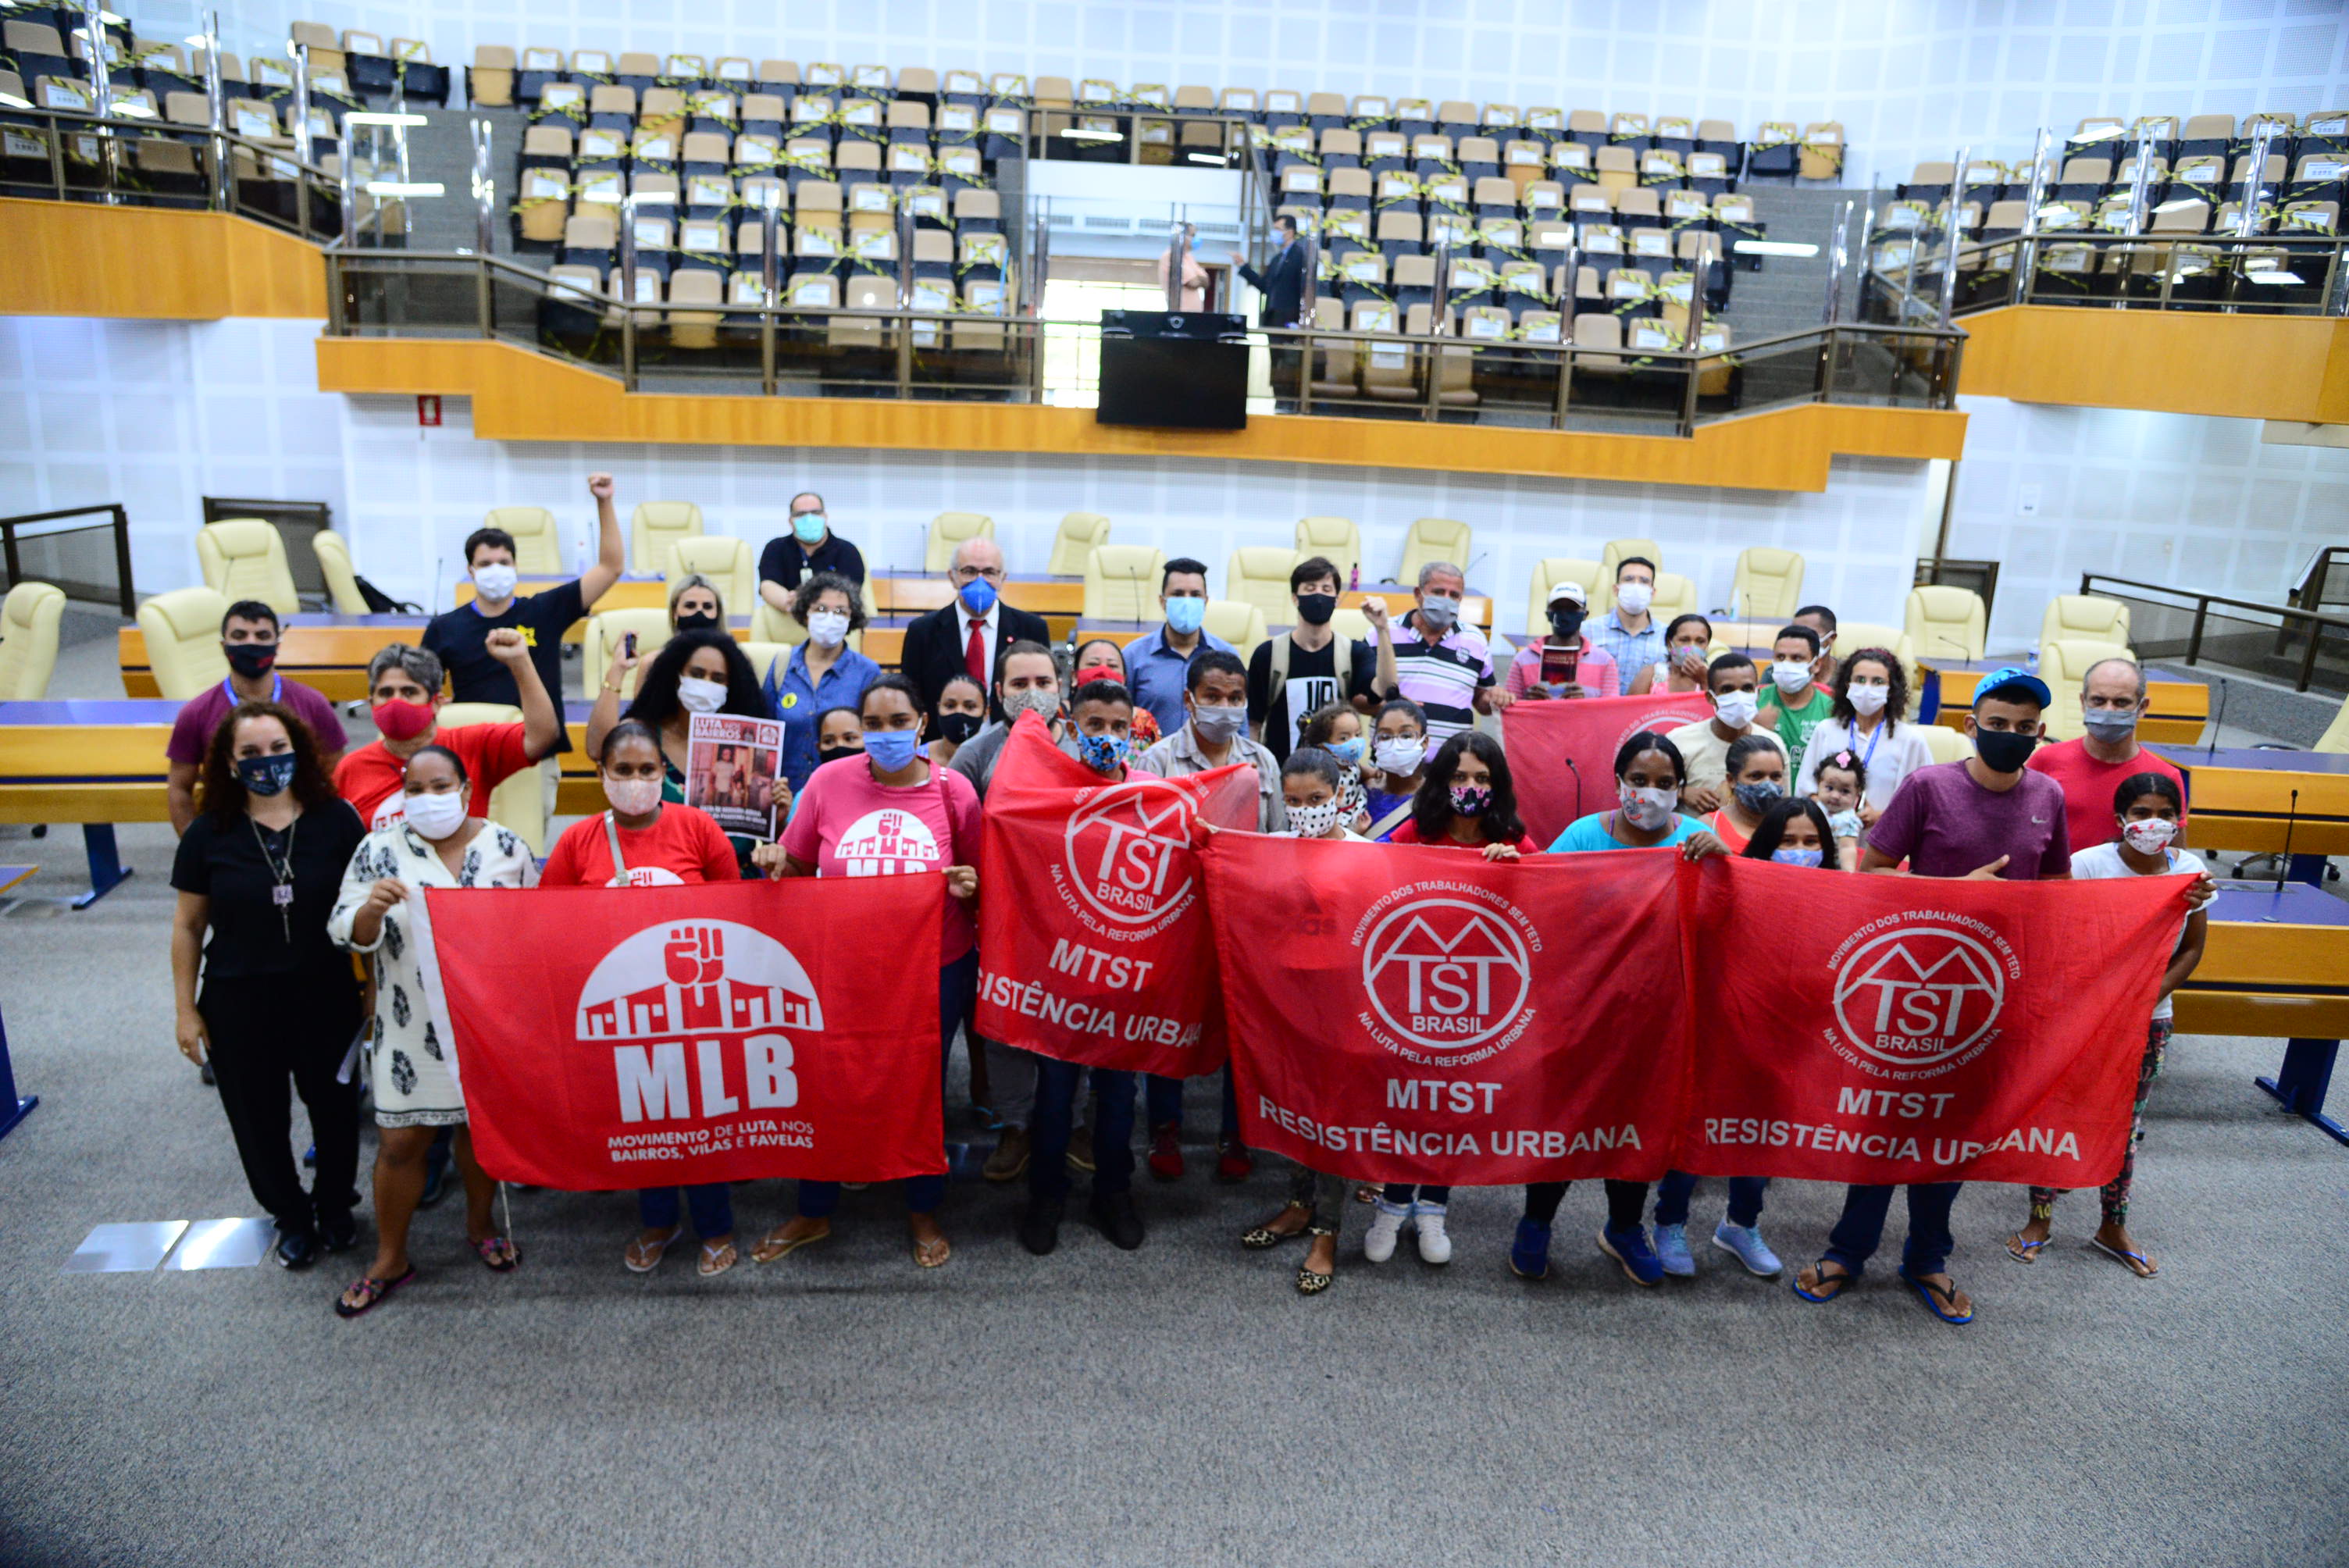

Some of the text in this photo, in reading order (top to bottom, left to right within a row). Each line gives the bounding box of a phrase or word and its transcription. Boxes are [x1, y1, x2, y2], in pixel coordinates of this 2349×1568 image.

[1050, 864, 1196, 943] NA LUTA PELA REFORMA URBANA
[1096, 882, 1158, 913] BRASIL
[1351, 894, 1392, 947] MOVIMENTO
[1391, 884, 1414, 902] DOS
[1415, 880, 1509, 910] TRABALHADORES
[1508, 904, 1530, 927] SEM
[1525, 925, 1543, 953] TETO
[1049, 937, 1153, 992] MTST
[1827, 910, 2022, 980] MOVIMENTO DOS TRABALHADORES SEM TETO
[1358, 1007, 1537, 1067] NA LUTA PELA REFORMA URBANA
[1412, 1015, 1488, 1033] BRASIL
[1875, 1035, 1952, 1052] BRASIL
[613, 1033, 799, 1123] MLB
[1823, 1027, 2003, 1081] NA LUTA PELA REFORMA URBANA
[1387, 1078, 1502, 1114] MTST
[1837, 1087, 1955, 1120] MTST
[608, 1120, 814, 1149] MOVIMENTO DE LUTA NOS
[611, 1134, 814, 1162] BAIRROS, VILAS E FAVELAS
[1259, 1094, 1643, 1160] RESISTÊNCIA URBANA
[1705, 1117, 1921, 1163] RESISTÊNCIA
